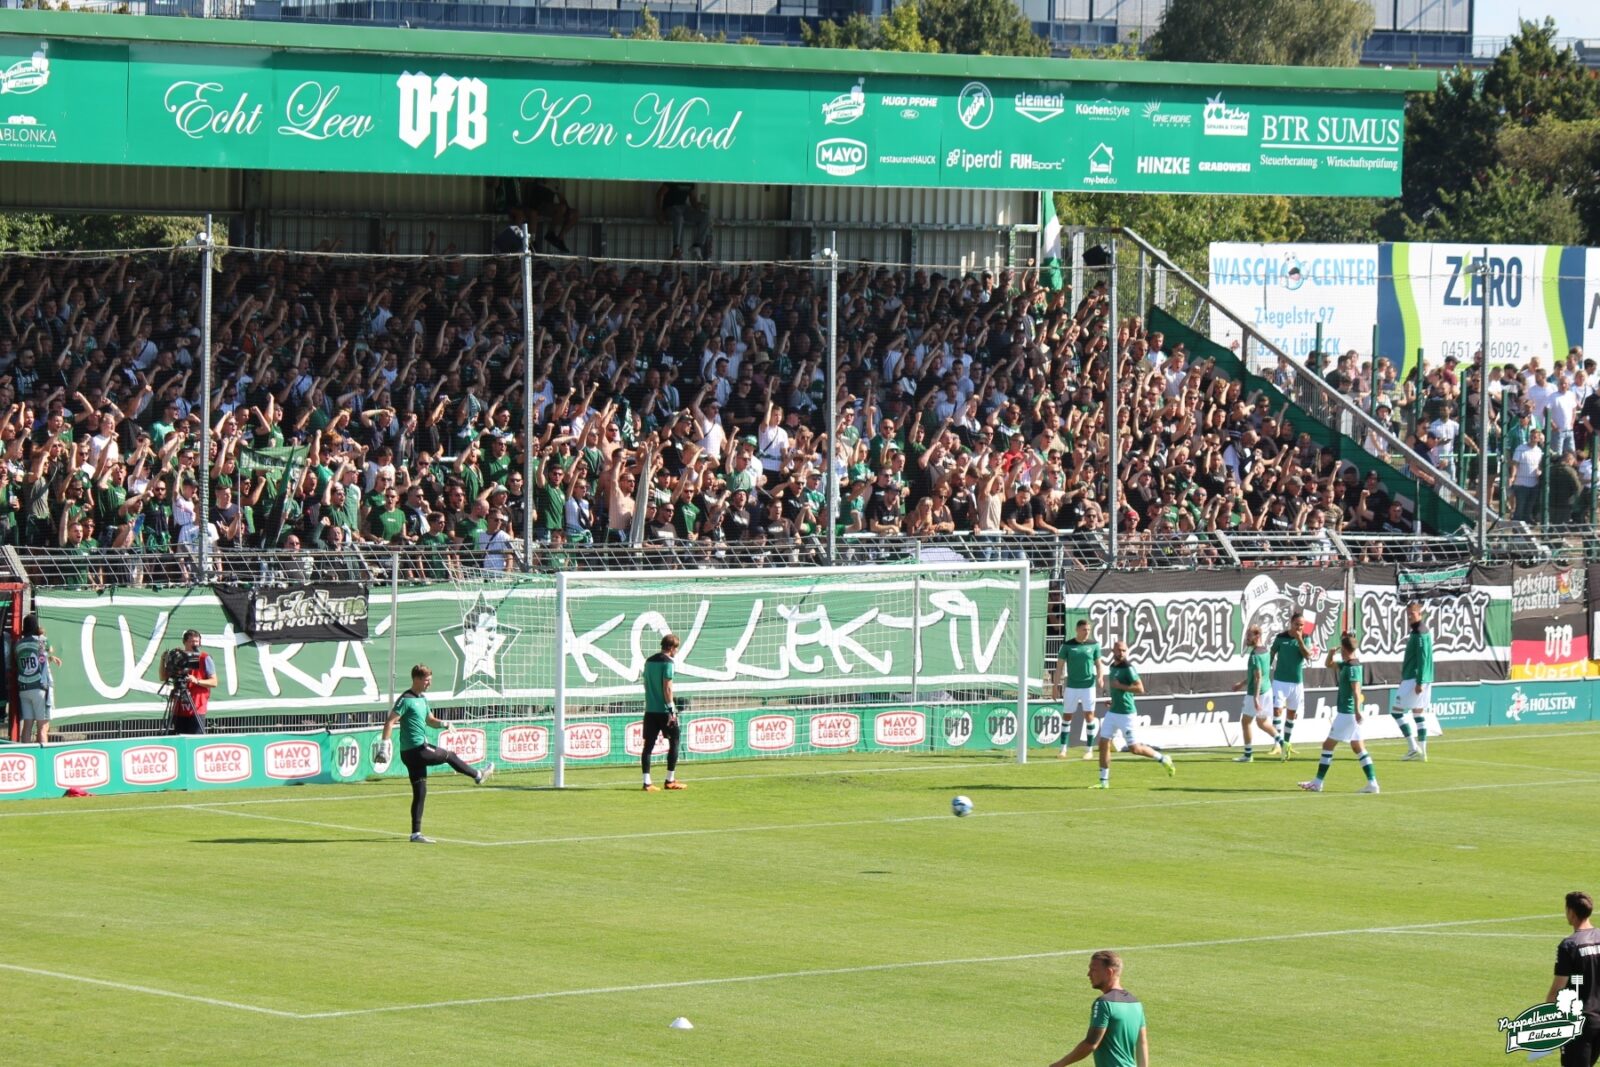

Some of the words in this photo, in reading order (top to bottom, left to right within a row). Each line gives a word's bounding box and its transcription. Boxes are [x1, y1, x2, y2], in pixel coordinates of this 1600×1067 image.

[881, 96, 907, 106] HUGO
[908, 97, 938, 107] PFOHE
[164, 81, 263, 139] Echt
[277, 81, 375, 140] Leev
[396, 70, 488, 160] VfB
[1075, 103, 1130, 118] Küchenstyle
[512, 88, 617, 147] Keen
[626, 93, 743, 150] Mood
[1261, 115, 1310, 141] BTR
[1317, 116, 1400, 145] SUMUS
[821, 146, 863, 163] MAYO
[961, 149, 1002, 172] iperdi
[1137, 156, 1190, 174] HINZKE
[1198, 162, 1251, 172] GRABOWSKI
[1260, 154, 1318, 169] Steuerberatung
[1326, 156, 1398, 171] Wirtschaftsprüfung
[1213, 257, 1278, 286] WASCH
[1312, 257, 1376, 286] CENTER
[1293, 332, 1340, 356] LÜBCK
[1544, 624, 1573, 662] VfB
[1430, 701, 1476, 716] HOLSTEN
[1529, 696, 1577, 711] HOLSTEN
[756, 721, 787, 732] MAYO
[818, 719, 851, 729] MAYO
[883, 717, 917, 727] MAYO
[508, 731, 540, 743] MAYO
[570, 728, 602, 740] MAYO
[695, 725, 727, 735] MAYO
[446, 733, 478, 745] MAYO
[131, 752, 168, 765] MAYO
[203, 750, 242, 762] MAYO
[273, 747, 311, 759] MAYO
[63, 756, 100, 768] MAYO
